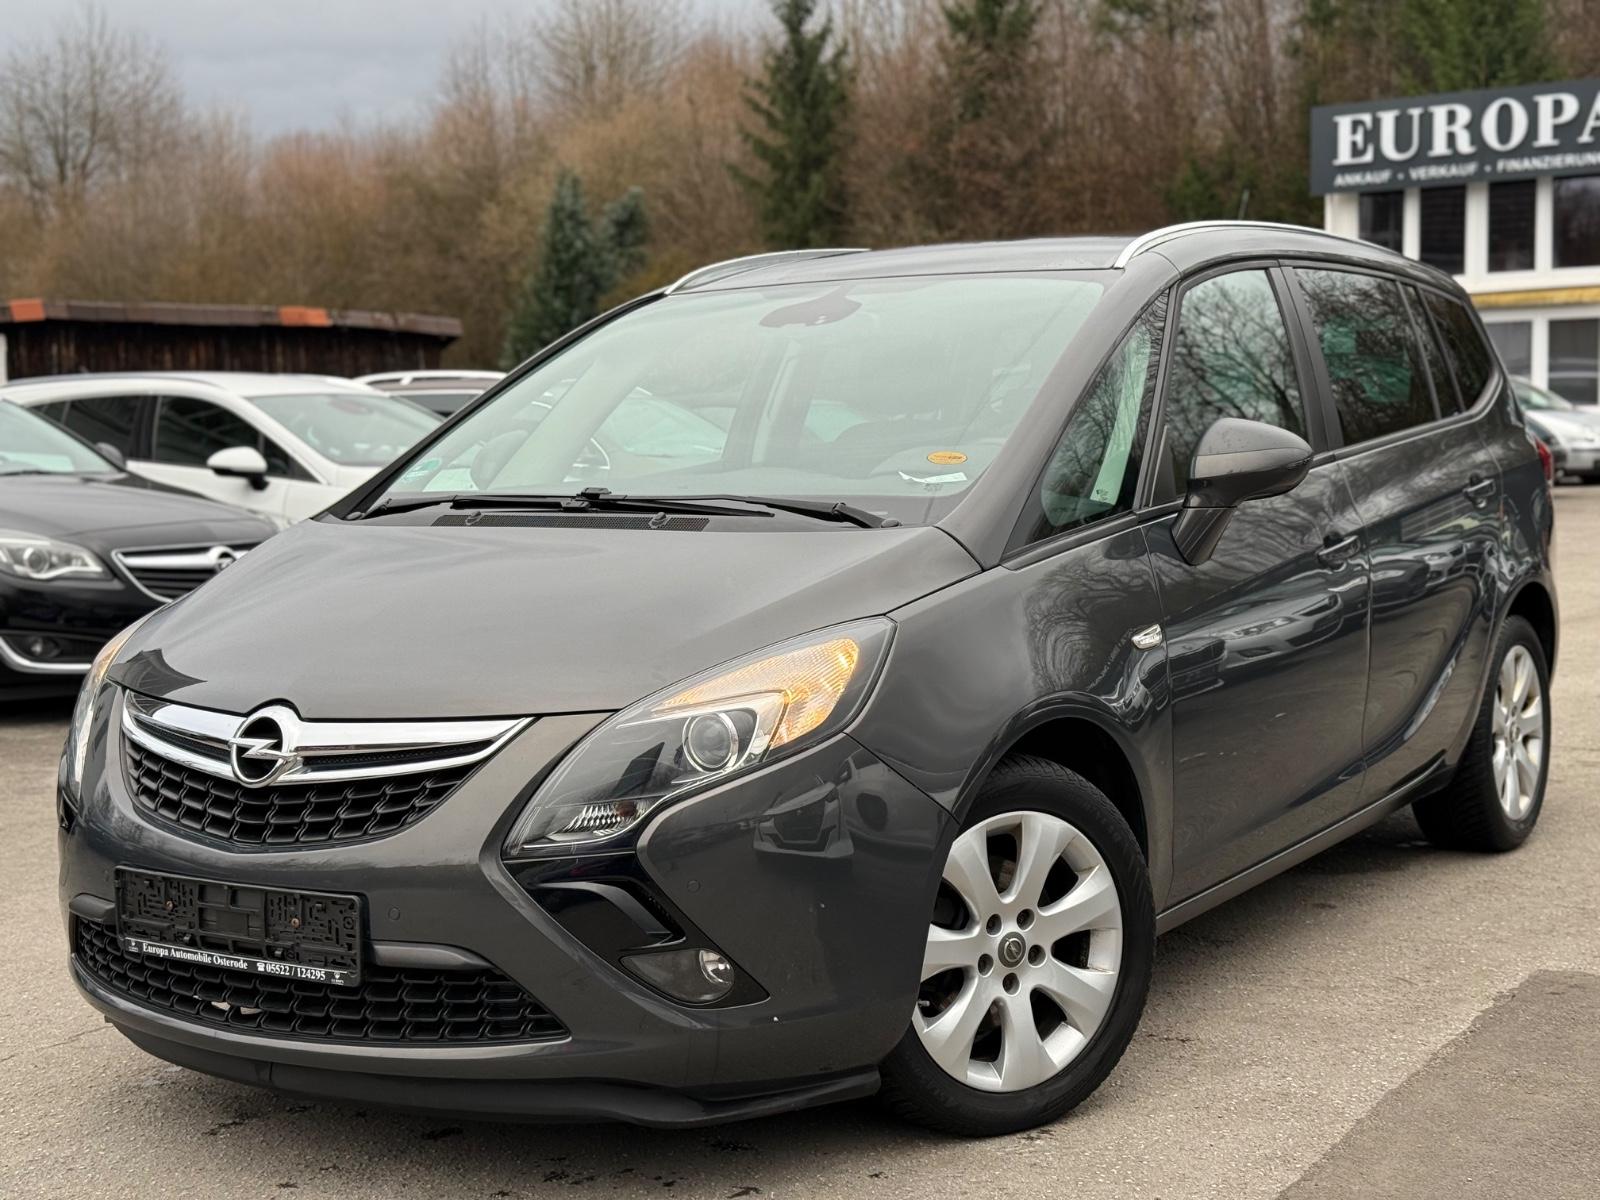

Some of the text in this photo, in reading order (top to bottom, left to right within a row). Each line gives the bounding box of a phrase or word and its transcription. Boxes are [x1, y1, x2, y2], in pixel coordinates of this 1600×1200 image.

[1333, 169, 1392, 187] ANKAUF
[1409, 161, 1478, 181] VERKAUF
[142, 942, 169, 957] Europa
[171, 948, 212, 964] Automobile
[213, 955, 248, 970] Osterode
[265, 962, 290, 976] 05522
[296, 967, 326, 981] 124295
